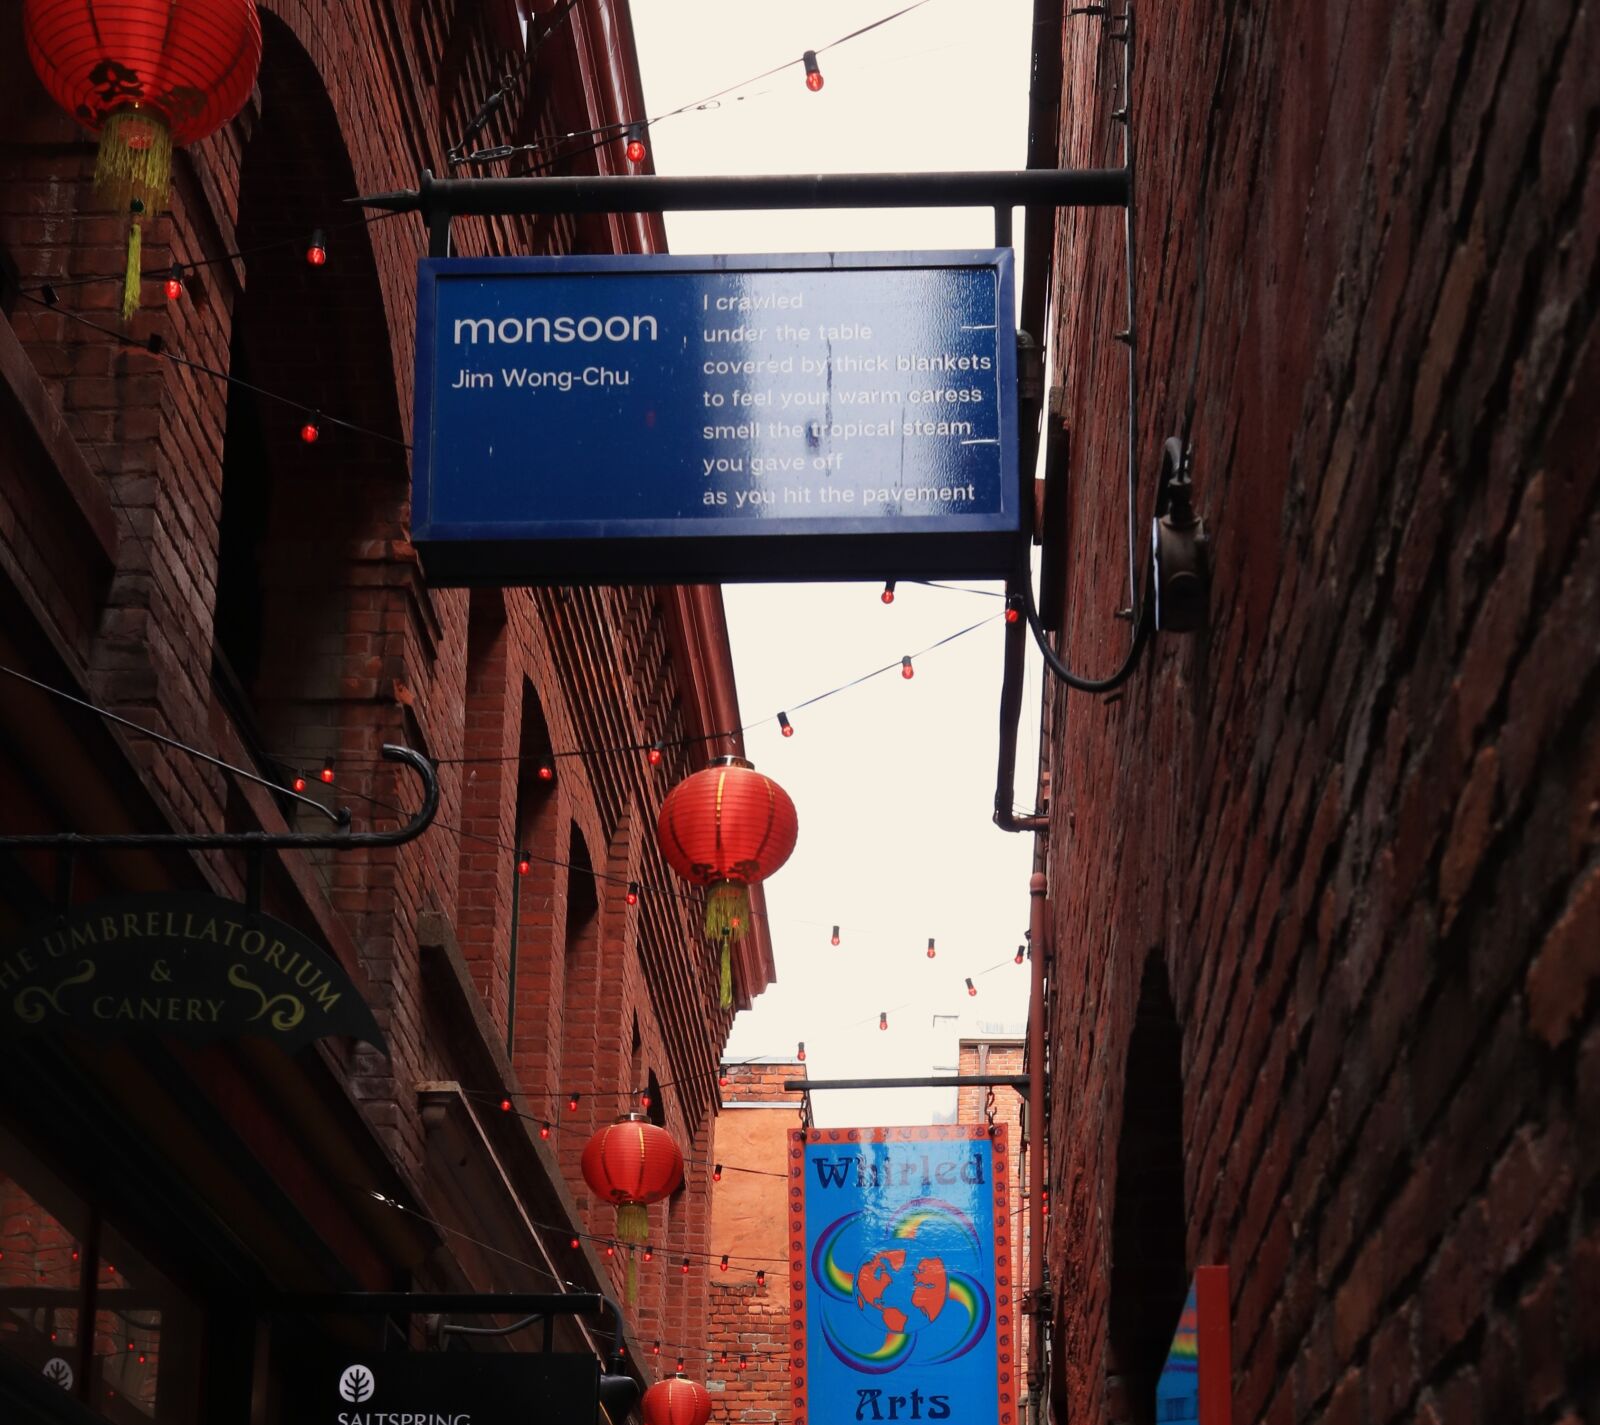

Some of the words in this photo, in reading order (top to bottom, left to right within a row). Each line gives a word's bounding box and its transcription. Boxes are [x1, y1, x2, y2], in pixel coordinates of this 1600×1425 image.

[703, 294, 709, 310] I
[715, 293, 803, 311] crawled
[453, 313, 659, 345] monsoon
[703, 324, 766, 343] under
[776, 323, 810, 341] the
[819, 323, 873, 341] table
[703, 356, 793, 375] covered
[802, 355, 828, 378] by
[835, 354, 888, 371] thick
[896, 353, 992, 371] blankets
[452, 368, 494, 390] Jim
[501, 366, 630, 392] Wong-Chu
[703, 390, 725, 407] to
[732, 388, 773, 407] feel
[781, 389, 830, 410] your
[838, 389, 902, 405] warm
[909, 386, 983, 404] caress
[703, 421, 760, 440] smell
[769, 420, 804, 438] the
[811, 419, 895, 442] tropical
[902, 418, 971, 436] steam
[703, 456, 743, 476] you
[750, 455, 804, 476] gave
[812, 452, 844, 470] off
[703, 488, 728, 506] as
[735, 488, 775, 508] you
[783, 484, 811, 503] hit
[818, 484, 853, 502] the
[862, 483, 975, 506] pavement
[0, 949, 40, 992] HE
[42, 911, 343, 1014] UMBRELLATORIUM
[149, 959, 174, 983] &
[92, 995, 226, 1023] CANERY
[811, 1154, 985, 1190] Whirled
[855, 1387, 951, 1421] Arts
